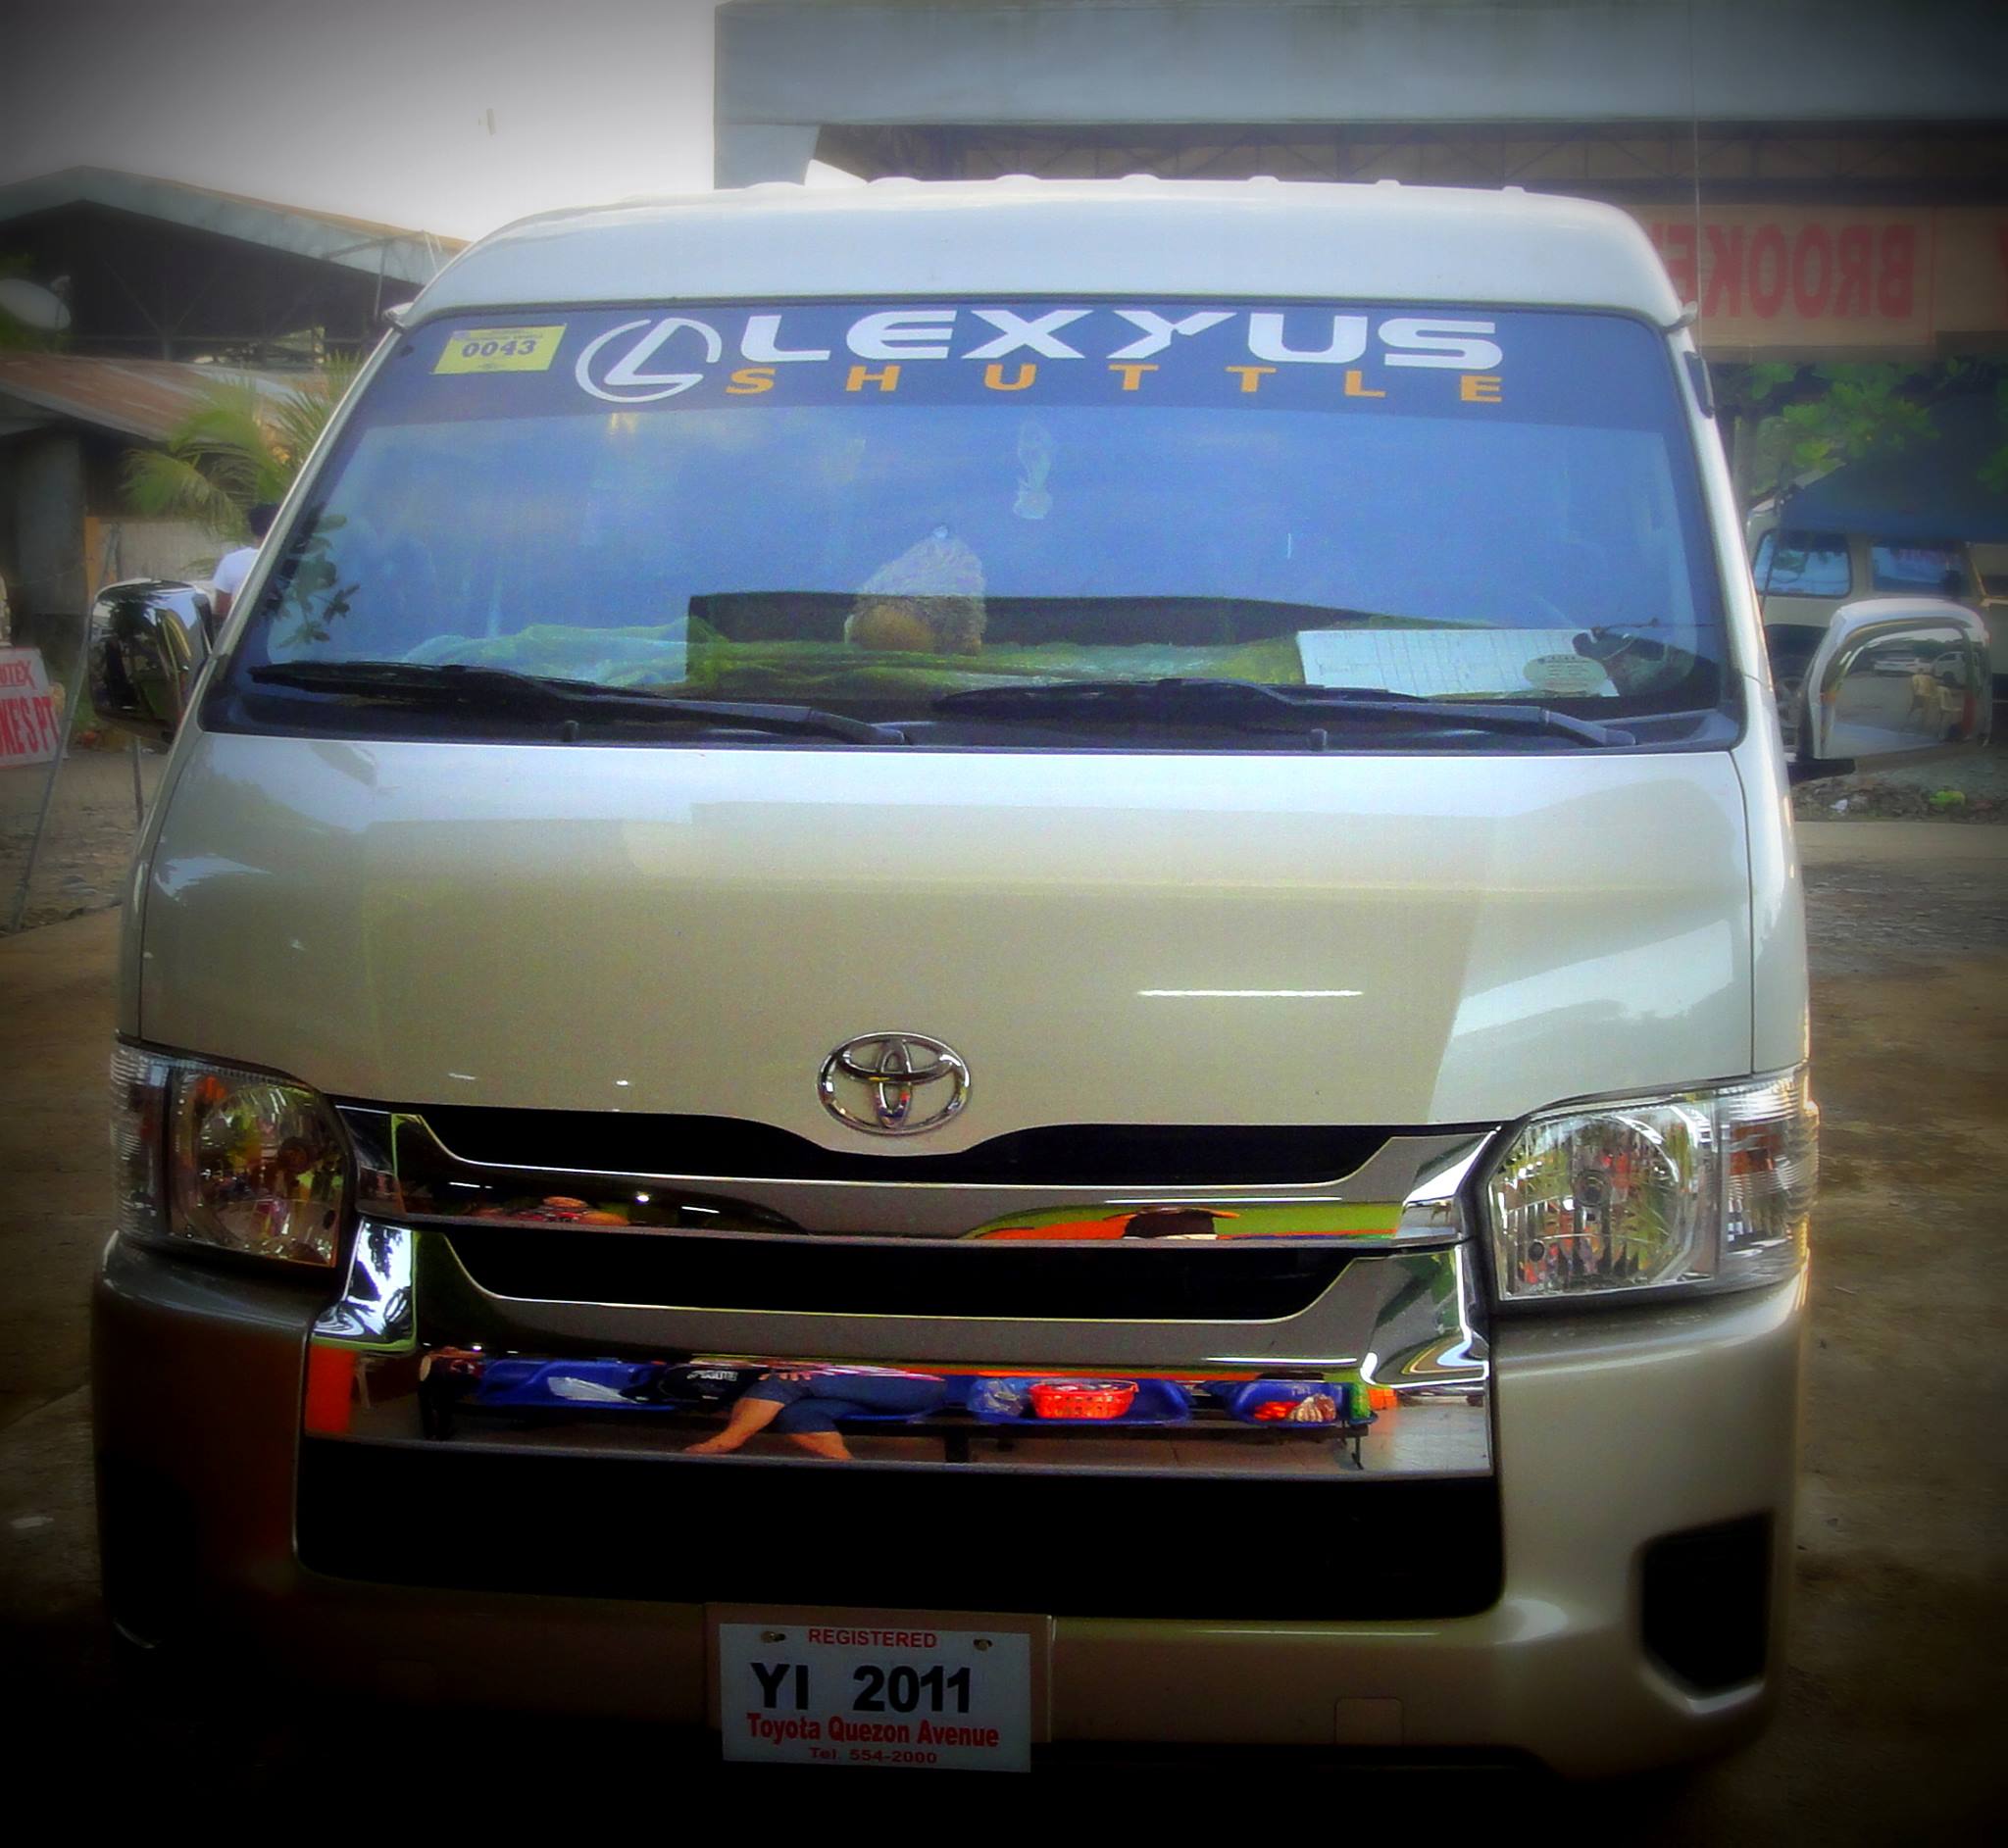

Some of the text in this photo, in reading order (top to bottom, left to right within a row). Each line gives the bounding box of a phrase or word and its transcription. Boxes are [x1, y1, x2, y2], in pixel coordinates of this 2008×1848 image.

[461, 339, 538, 359] 0043
[740, 309, 1503, 370] LEXYUS
[726, 363, 1503, 403] SHUTTLE
[808, 1628, 938, 1648] REGISTERED
[750, 1662, 972, 1714] YI 2011
[746, 1713, 1000, 1747] Toyota Quezon Avenue
[849, 1748, 938, 1765] 554-2000
